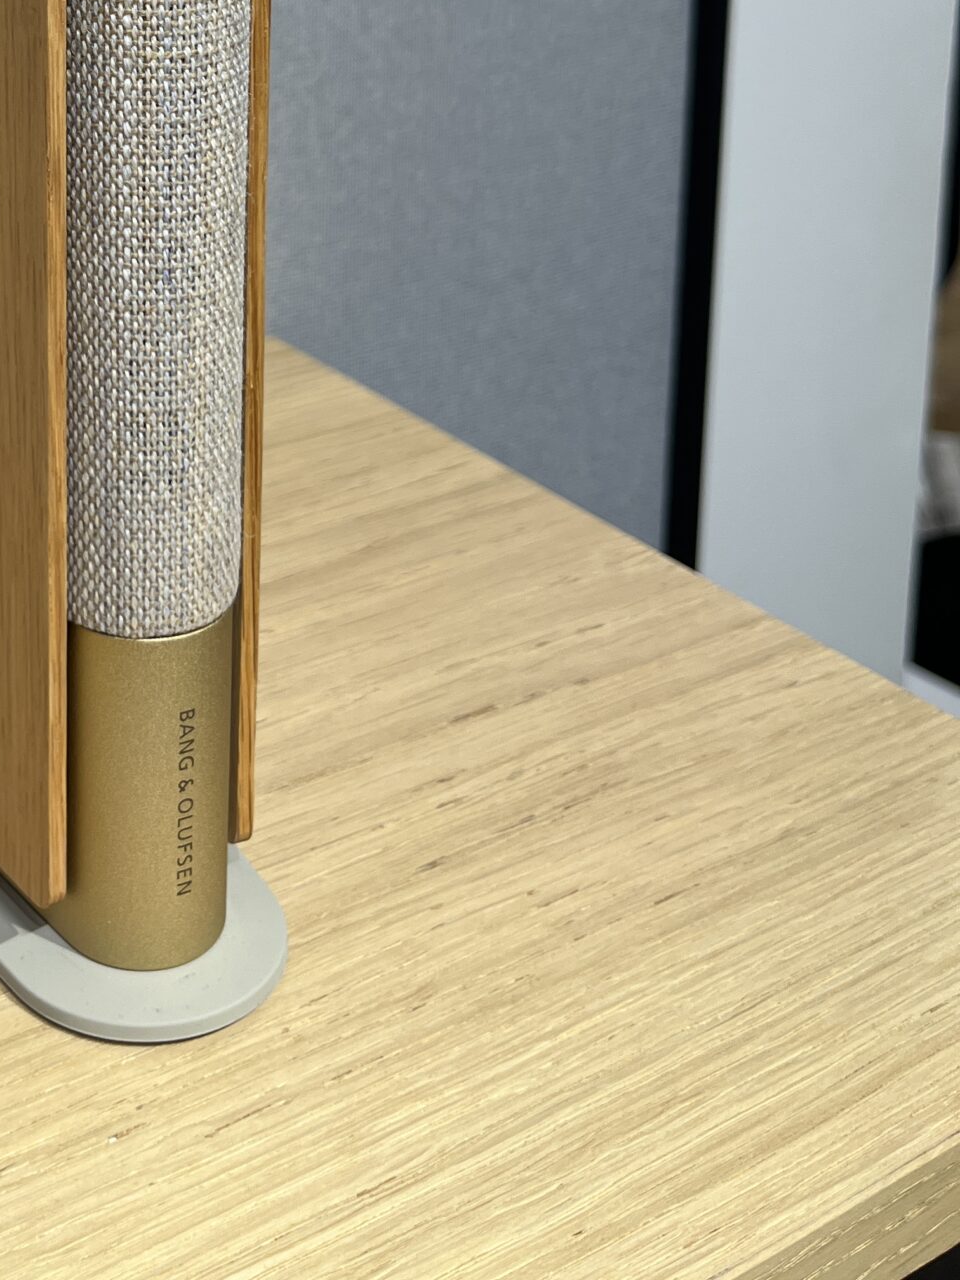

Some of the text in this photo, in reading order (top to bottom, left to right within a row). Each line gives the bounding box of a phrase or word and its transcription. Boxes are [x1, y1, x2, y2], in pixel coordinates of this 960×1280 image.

[176, 708, 195, 897] BANG & OLUFSEN
